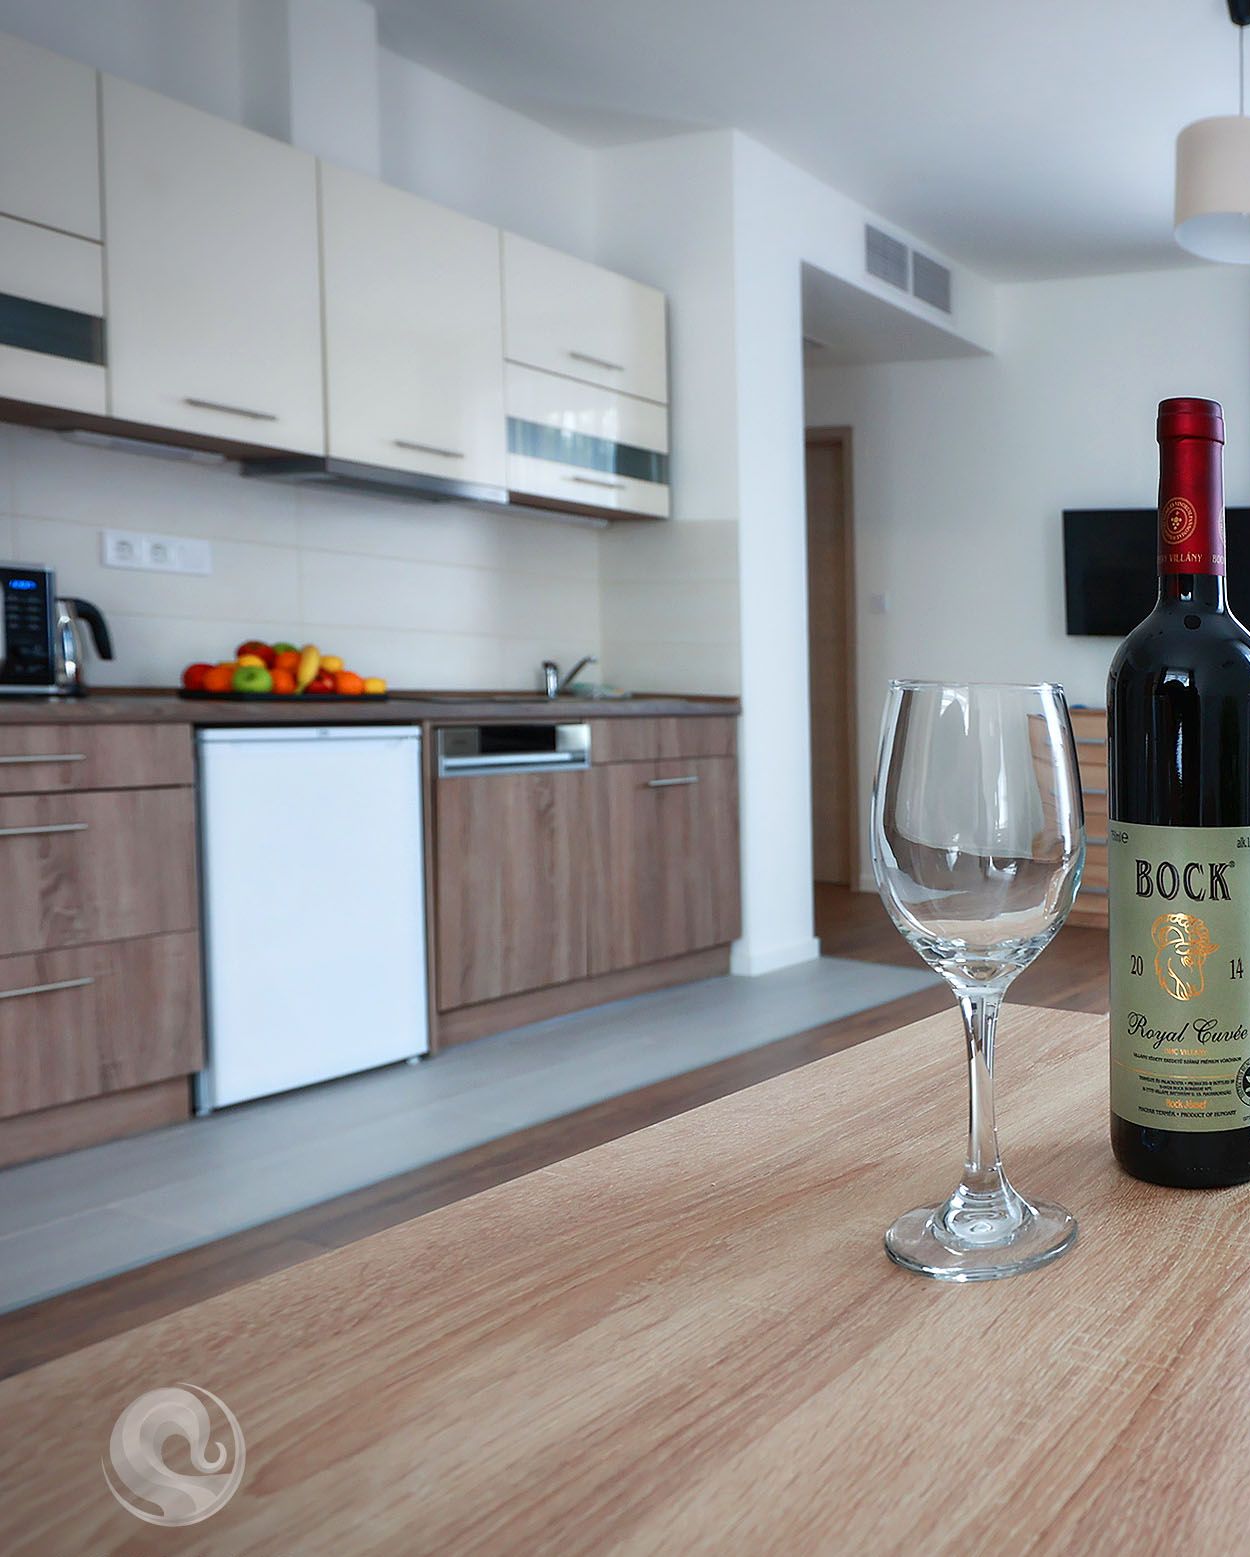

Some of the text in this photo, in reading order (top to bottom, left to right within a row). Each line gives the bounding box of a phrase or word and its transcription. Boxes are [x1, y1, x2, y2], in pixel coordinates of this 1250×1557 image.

[1168, 551, 1203, 563] VILLÁNY
[1130, 954, 1144, 977] 20
[1229, 957, 1245, 980] 14
[1127, 1011, 1249, 1050] Royal Cuvée
